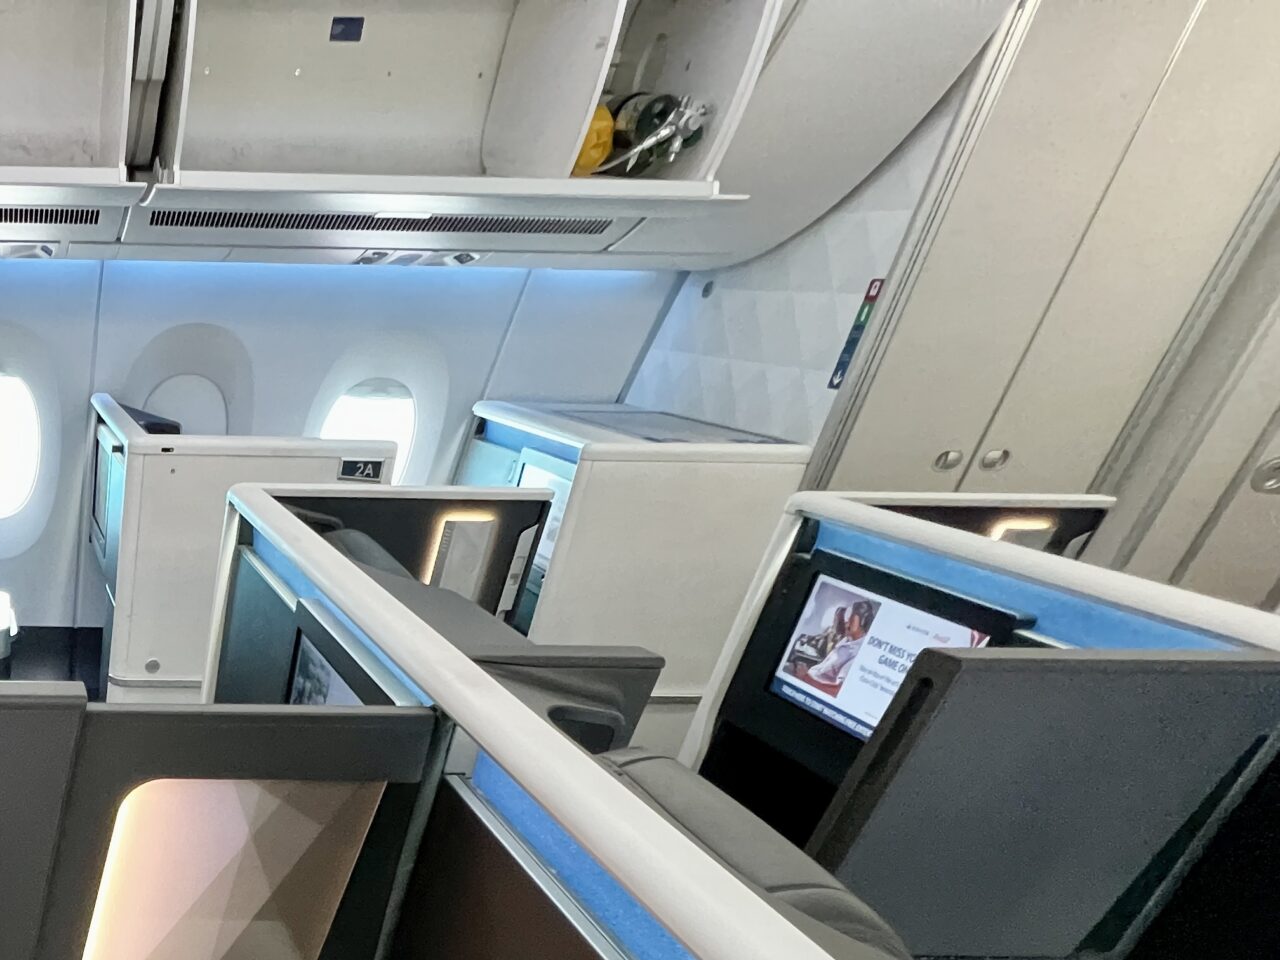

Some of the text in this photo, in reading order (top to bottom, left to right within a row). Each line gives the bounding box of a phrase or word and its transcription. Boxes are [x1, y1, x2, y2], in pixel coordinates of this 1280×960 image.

[354, 463, 374, 477] 2A
[888, 645, 907, 659] MISS
[878, 654, 900, 671] GAME
